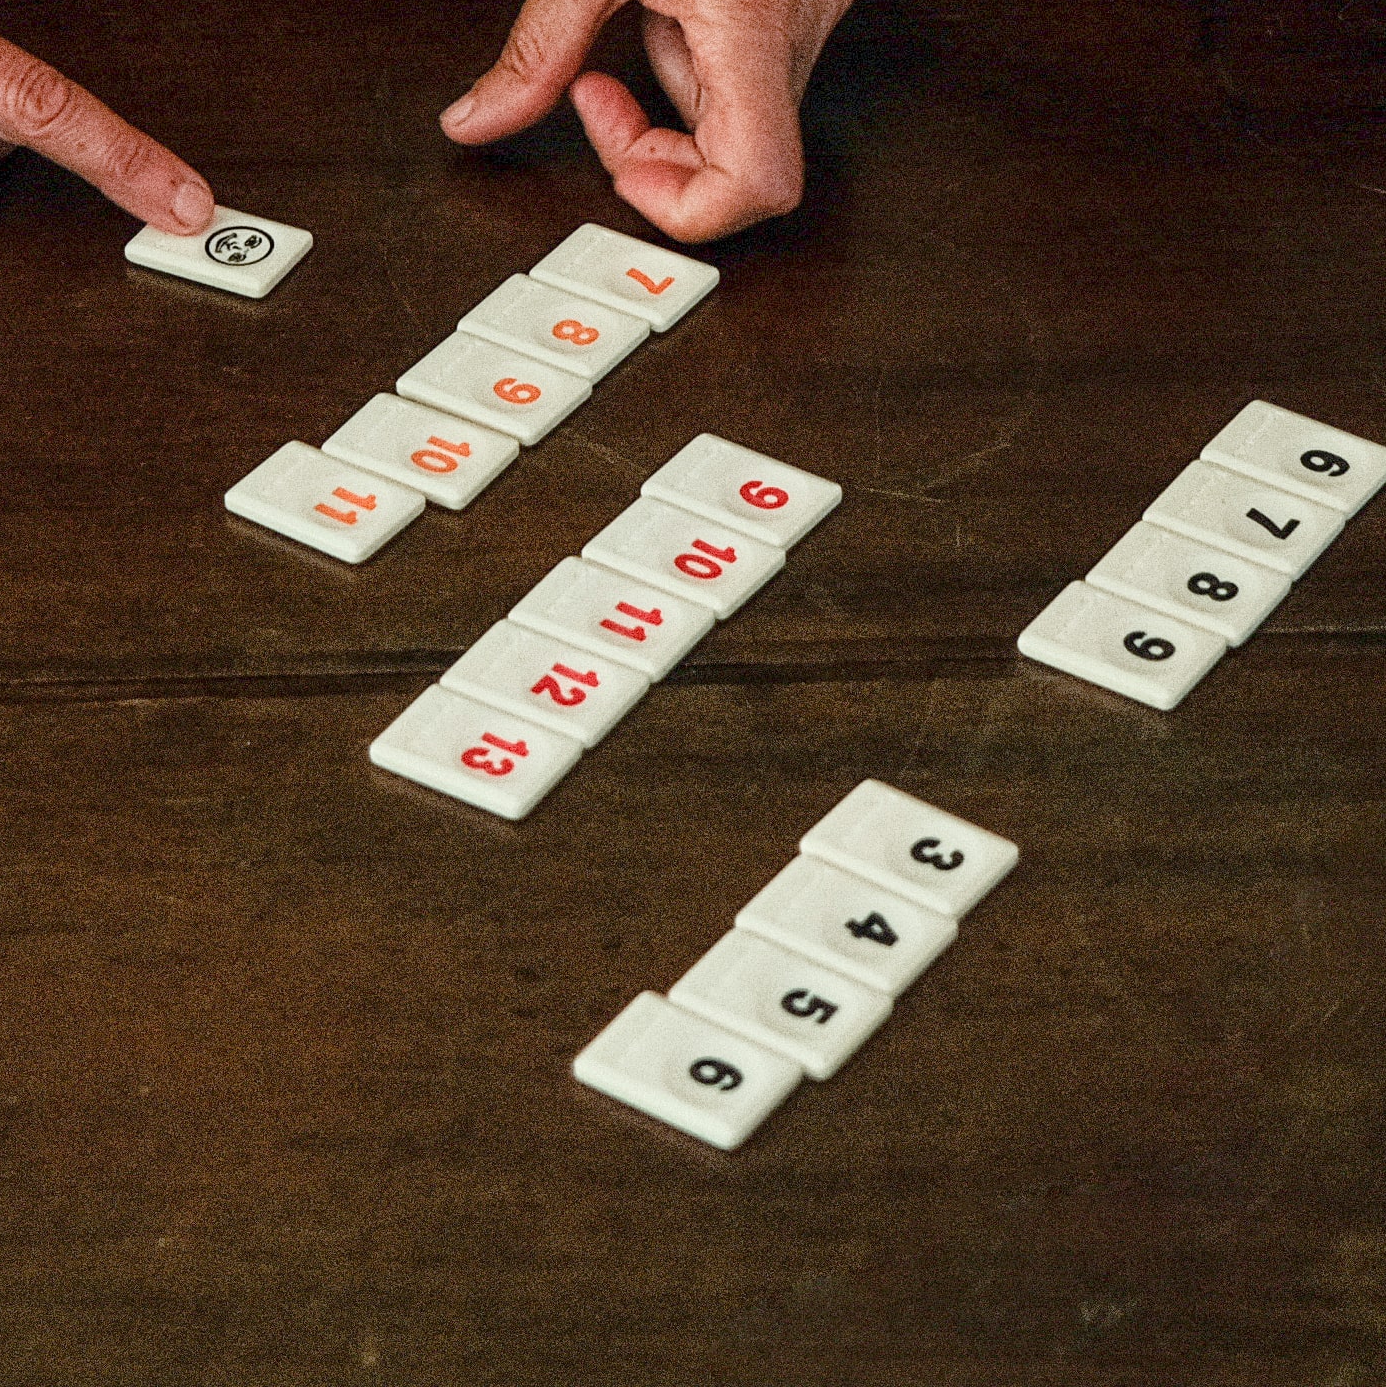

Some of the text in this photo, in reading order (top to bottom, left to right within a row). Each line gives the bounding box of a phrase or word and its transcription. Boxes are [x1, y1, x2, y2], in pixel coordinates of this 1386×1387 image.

[624, 266, 677, 298] 7
[550, 317, 602, 348] 8
[491, 376, 544, 407] 9
[408, 434, 474, 476] 10
[1298, 448, 1351, 478] 6
[312, 485, 379, 528] 11
[737, 478, 791, 512] 9
[1245, 507, 1301, 541] 7
[672, 537, 739, 582] 10
[1186, 571, 1240, 603] 8
[598, 600, 665, 644] 11
[1122, 630, 1177, 663] 9
[528, 661, 602, 709] 12
[459, 731, 531, 779] 13
[909, 837, 965, 872] 3
[844, 912, 899, 948] 4
[780, 989, 839, 1025] 5
[688, 1058, 744, 1092] 6
